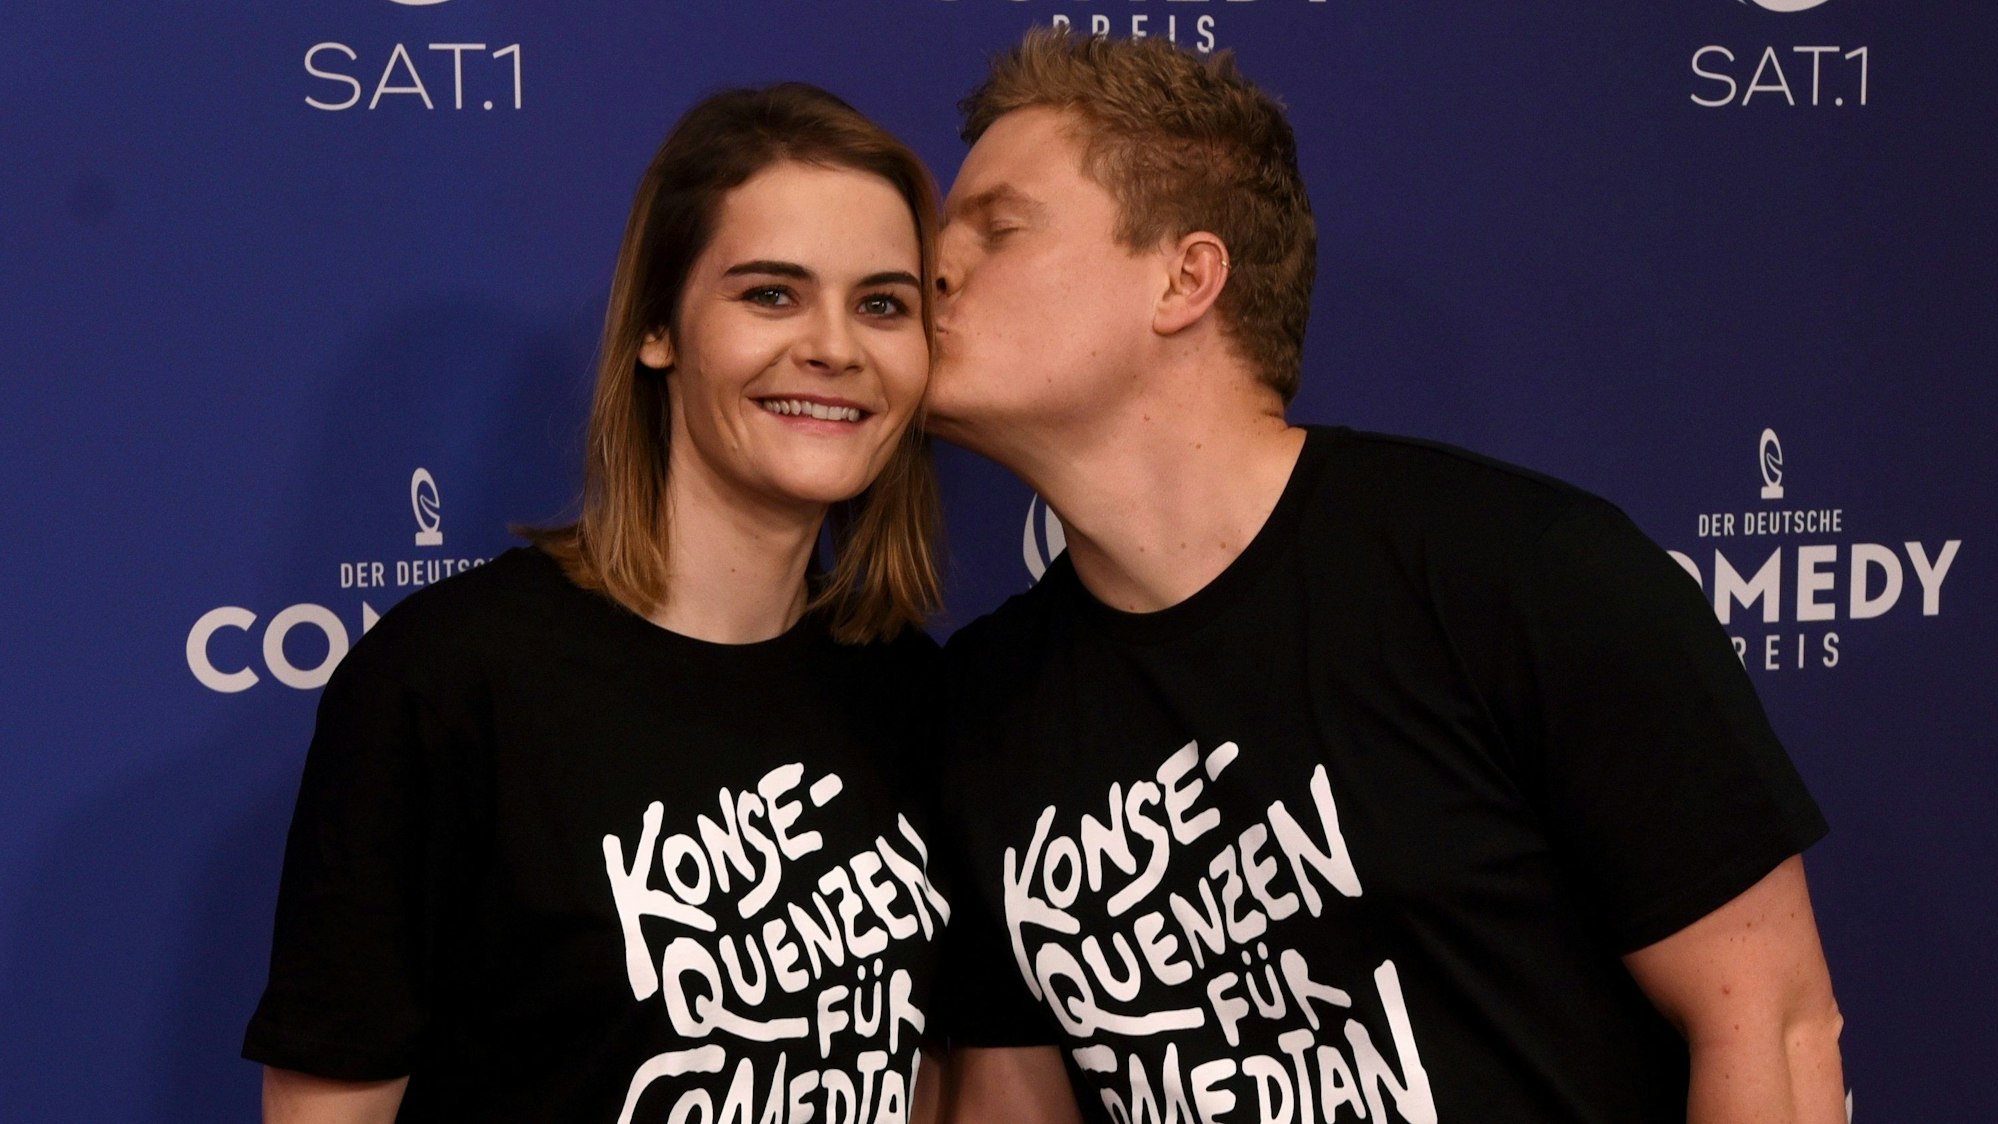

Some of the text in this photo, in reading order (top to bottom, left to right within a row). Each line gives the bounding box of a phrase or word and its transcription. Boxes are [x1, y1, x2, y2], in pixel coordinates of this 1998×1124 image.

[304, 42, 521, 110] SAT.1
[1690, 45, 1867, 107] SAT.1
[1698, 509, 1842, 537] DER DEUTSCHE
[340, 562, 385, 588] DER
[1667, 539, 1962, 625] MEDY
[186, 601, 381, 693] CO
[1036, 763, 1363, 1037] QUENZEN
[817, 958, 926, 1059] FÜR
[1207, 942, 1352, 1047] FÜR
[617, 1044, 921, 1124] COMEDIA
